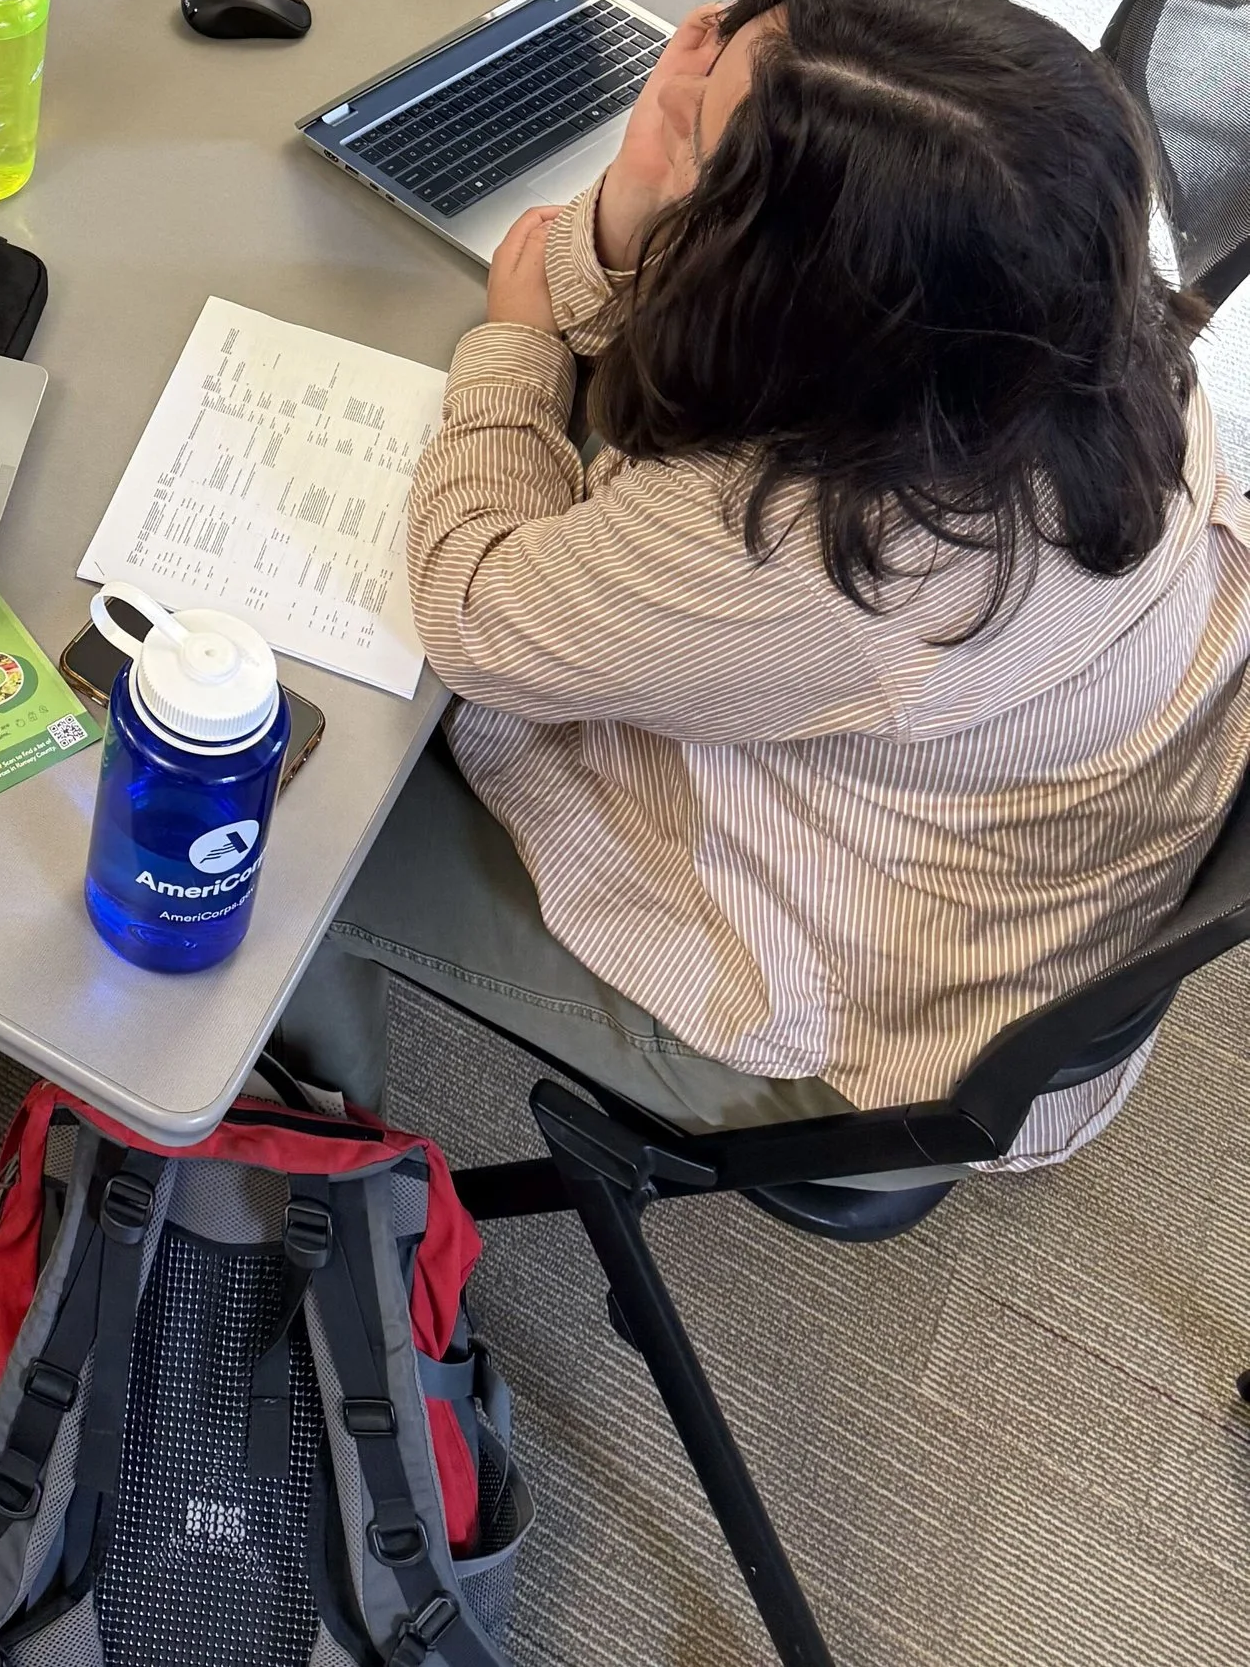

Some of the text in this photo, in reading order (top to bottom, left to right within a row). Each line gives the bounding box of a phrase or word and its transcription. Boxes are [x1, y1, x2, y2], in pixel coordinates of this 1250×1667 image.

[2, 756, 17, 769] Scan
[21, 747, 34, 758] find
[37, 740, 46, 751] list
[135, 851, 263, 899] AmeriCor
